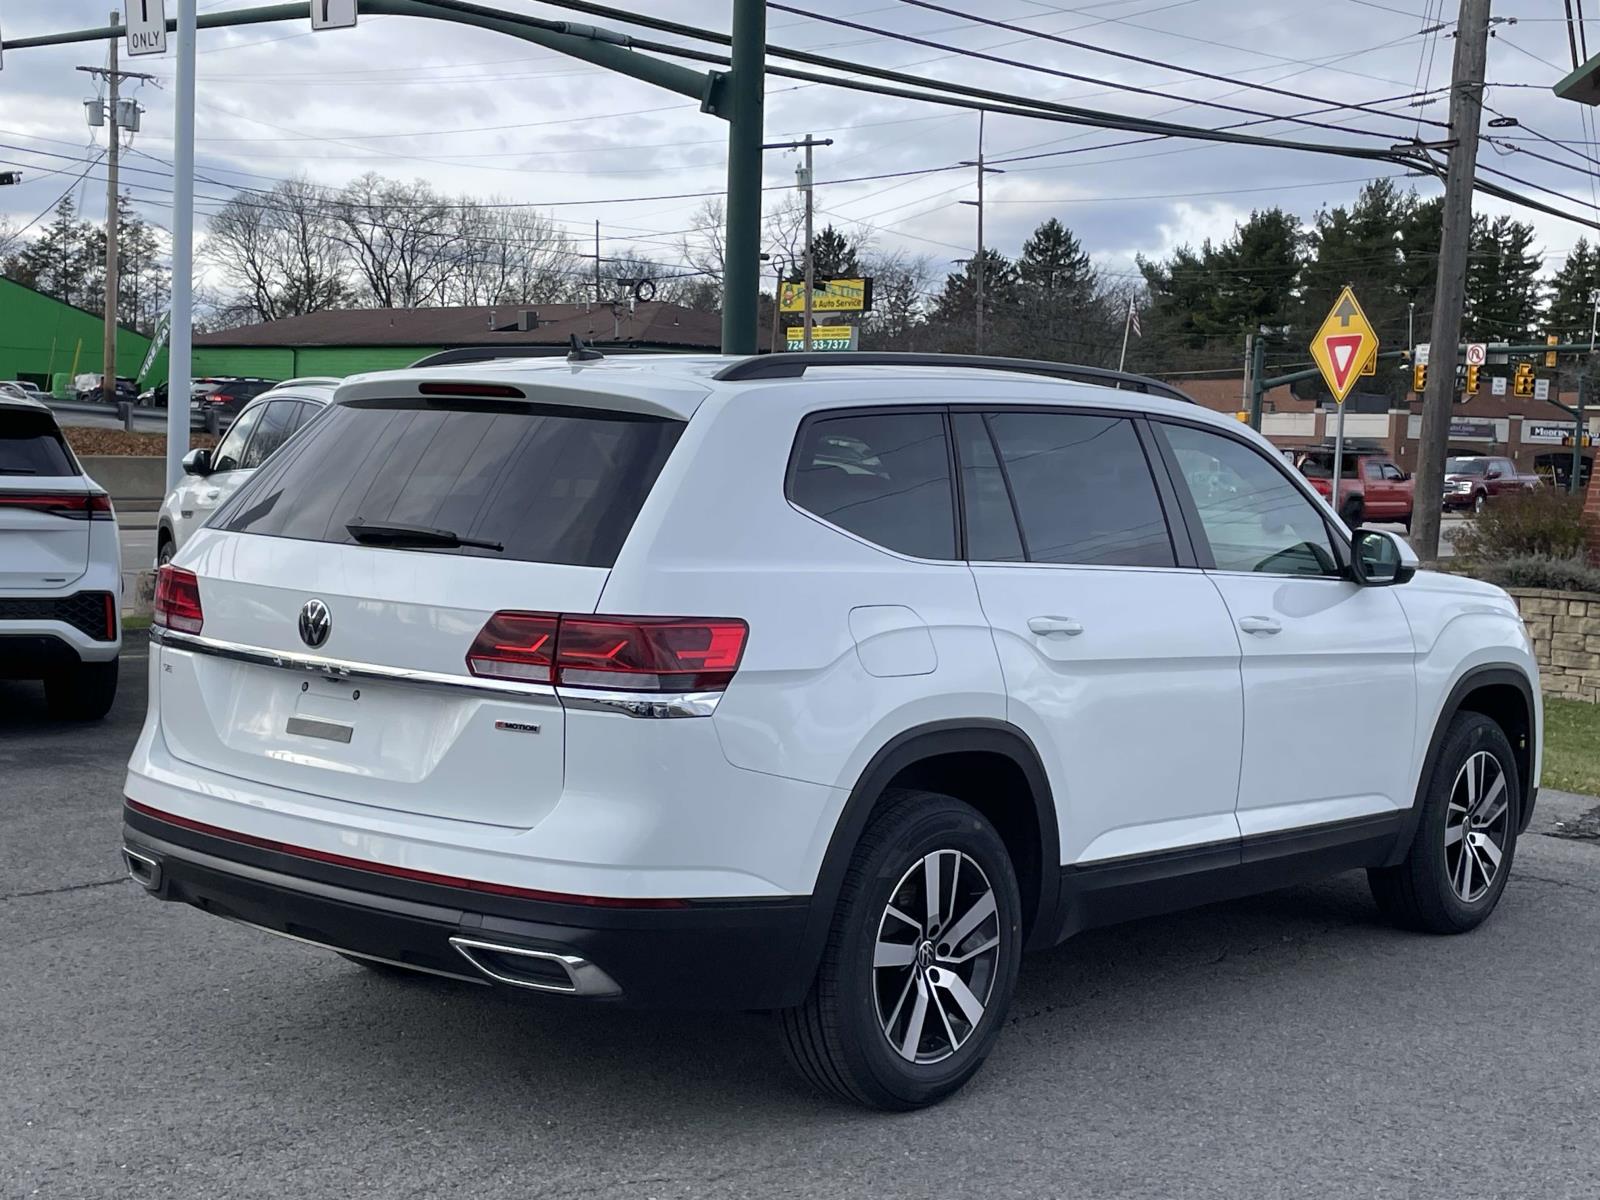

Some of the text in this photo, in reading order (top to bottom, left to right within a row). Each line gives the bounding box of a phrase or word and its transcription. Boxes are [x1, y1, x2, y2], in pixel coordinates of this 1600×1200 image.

[132, 30, 160, 49] ONLY
[819, 299, 834, 308] Auto
[836, 298, 862, 308] Service
[787, 340, 850, 350] 72433-7377
